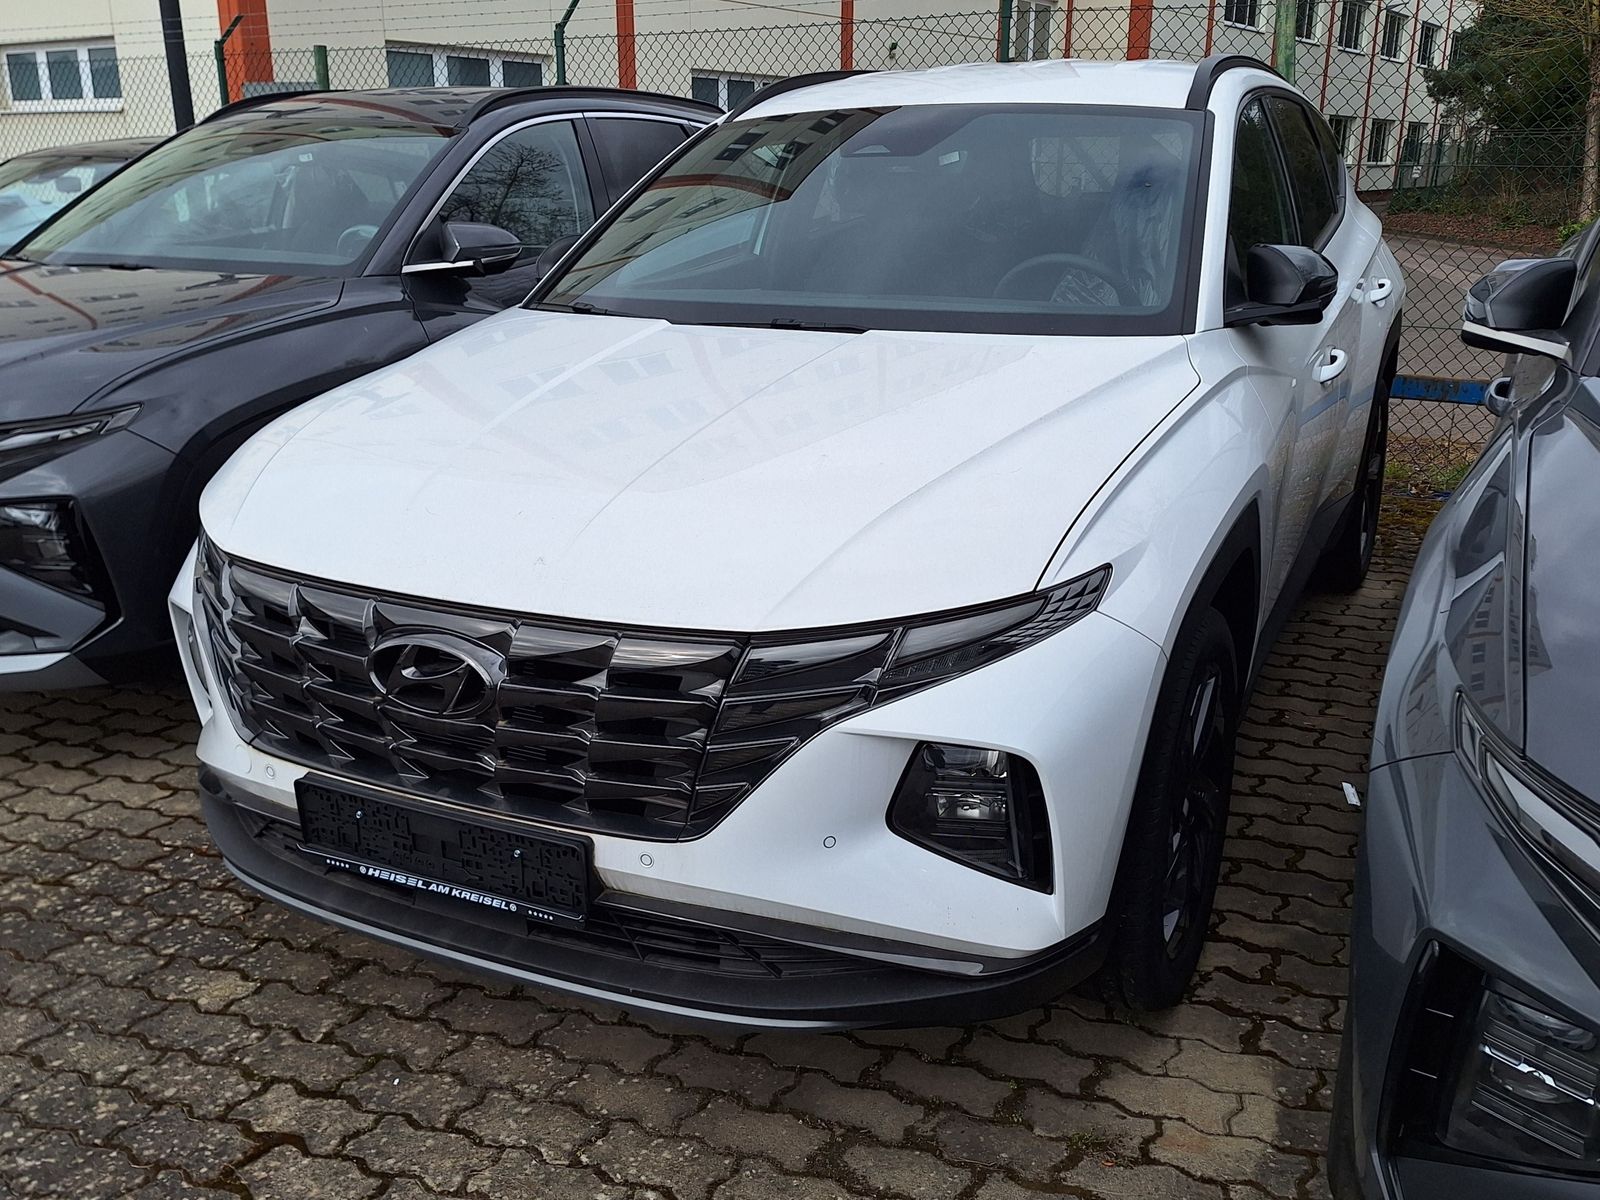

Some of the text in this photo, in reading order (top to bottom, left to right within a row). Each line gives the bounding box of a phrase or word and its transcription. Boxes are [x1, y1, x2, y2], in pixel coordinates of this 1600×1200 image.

[367, 867, 509, 910] HEISEL AM KREISEL
